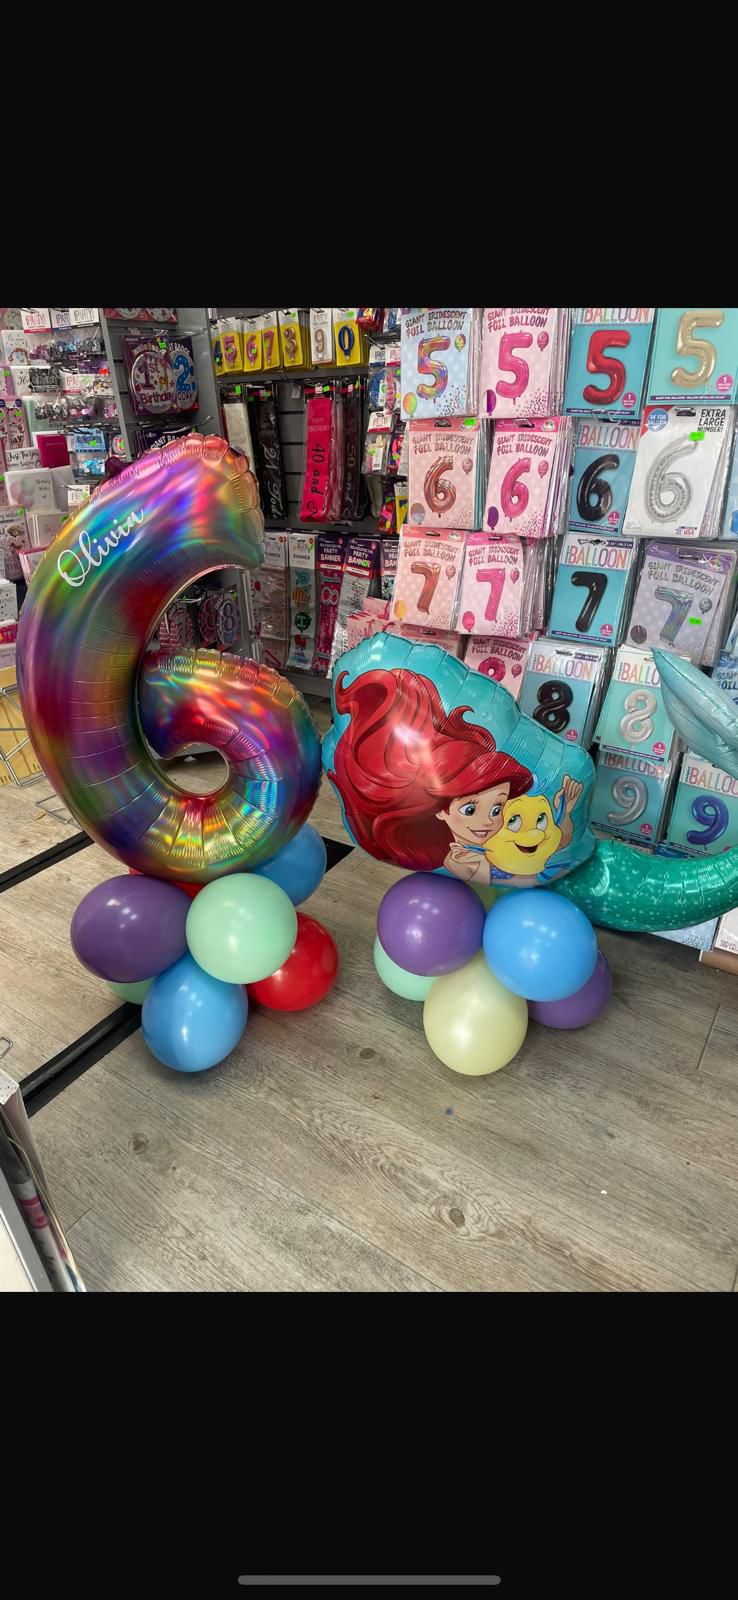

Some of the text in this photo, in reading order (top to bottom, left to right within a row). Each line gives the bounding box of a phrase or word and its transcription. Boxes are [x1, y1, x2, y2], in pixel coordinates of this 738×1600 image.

[406, 310, 467, 328] GIANT IRIDESCENT
[488, 316, 548, 333] FOIL BALLOON
[406, 320, 464, 338] FOIL BALLOON
[701, 408, 726, 418] EXTRA
[699, 418, 725, 426] LARGE
[412, 433, 474, 444] GIANT IRIDESCENT
[497, 434, 552, 446] GIANT IRIDESCENT
[580, 424, 640, 448] BALLOON
[414, 444, 471, 455] FOIL BALLOON
[497, 444, 549, 457] FOIL BALLOON
[58, 509, 144, 587] Olivia
[353, 550, 368, 558] PARTY
[320, 554, 341, 562] BANNER
[404, 549, 420, 557] FOIL
[423, 550, 456, 562] BALLOON
[469, 555, 518, 567] FOIL BALLOON
[568, 545, 627, 568] BALLOON
[648, 562, 720, 586] GIANT IRIDESCENT
[648, 570, 715, 595] FOIL BALLOON
[491, 646, 523, 661] BALLOON
[536, 654, 593, 680] BALLOON
